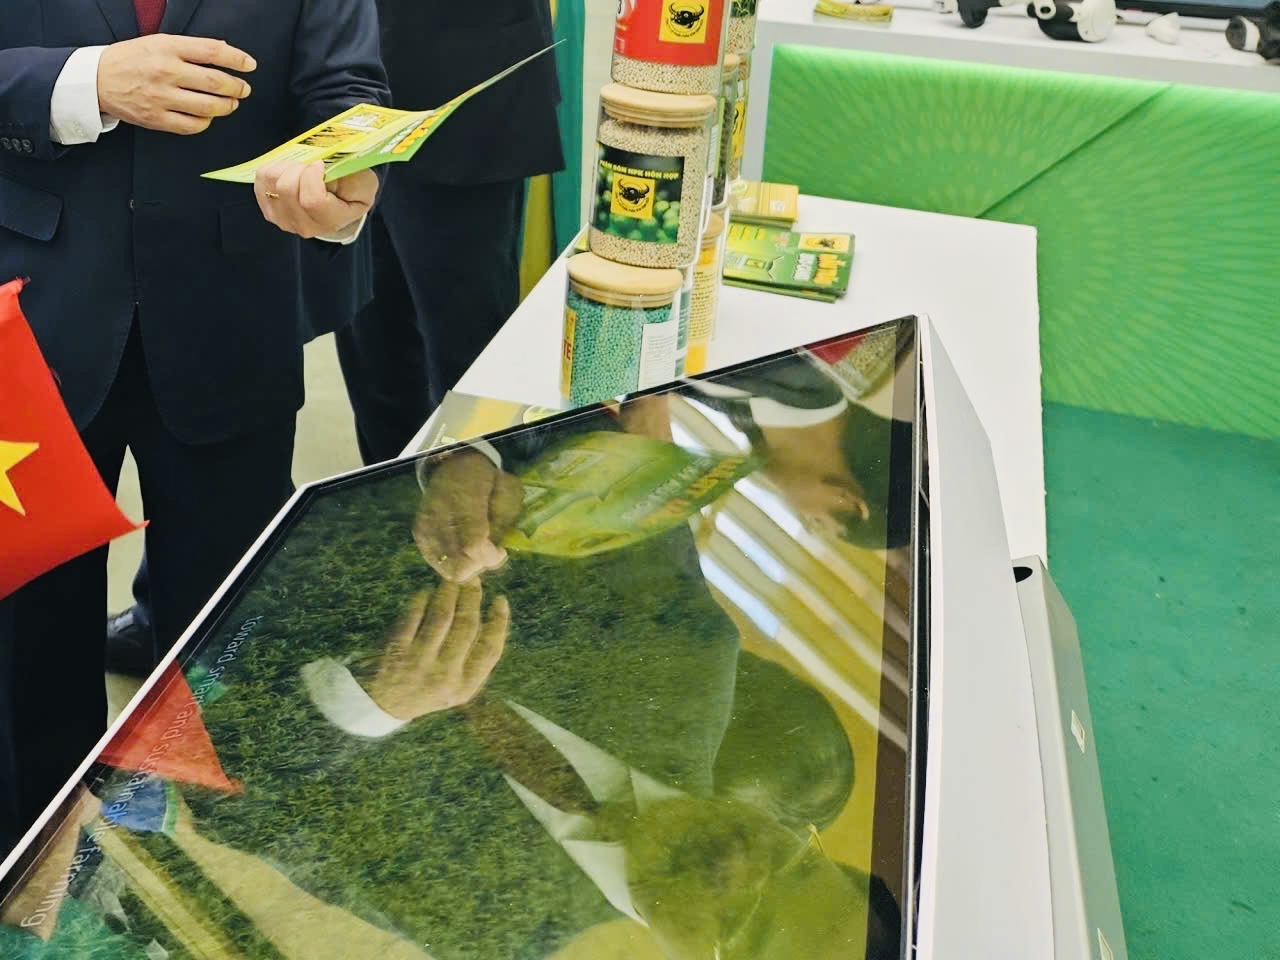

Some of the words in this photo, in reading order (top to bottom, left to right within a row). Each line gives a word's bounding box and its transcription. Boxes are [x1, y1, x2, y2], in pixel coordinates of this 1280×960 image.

[217, 615, 264, 664] toward
[163, 709, 193, 741] and
[87, 741, 169, 843] sustainable
[20, 847, 102, 929] farming
